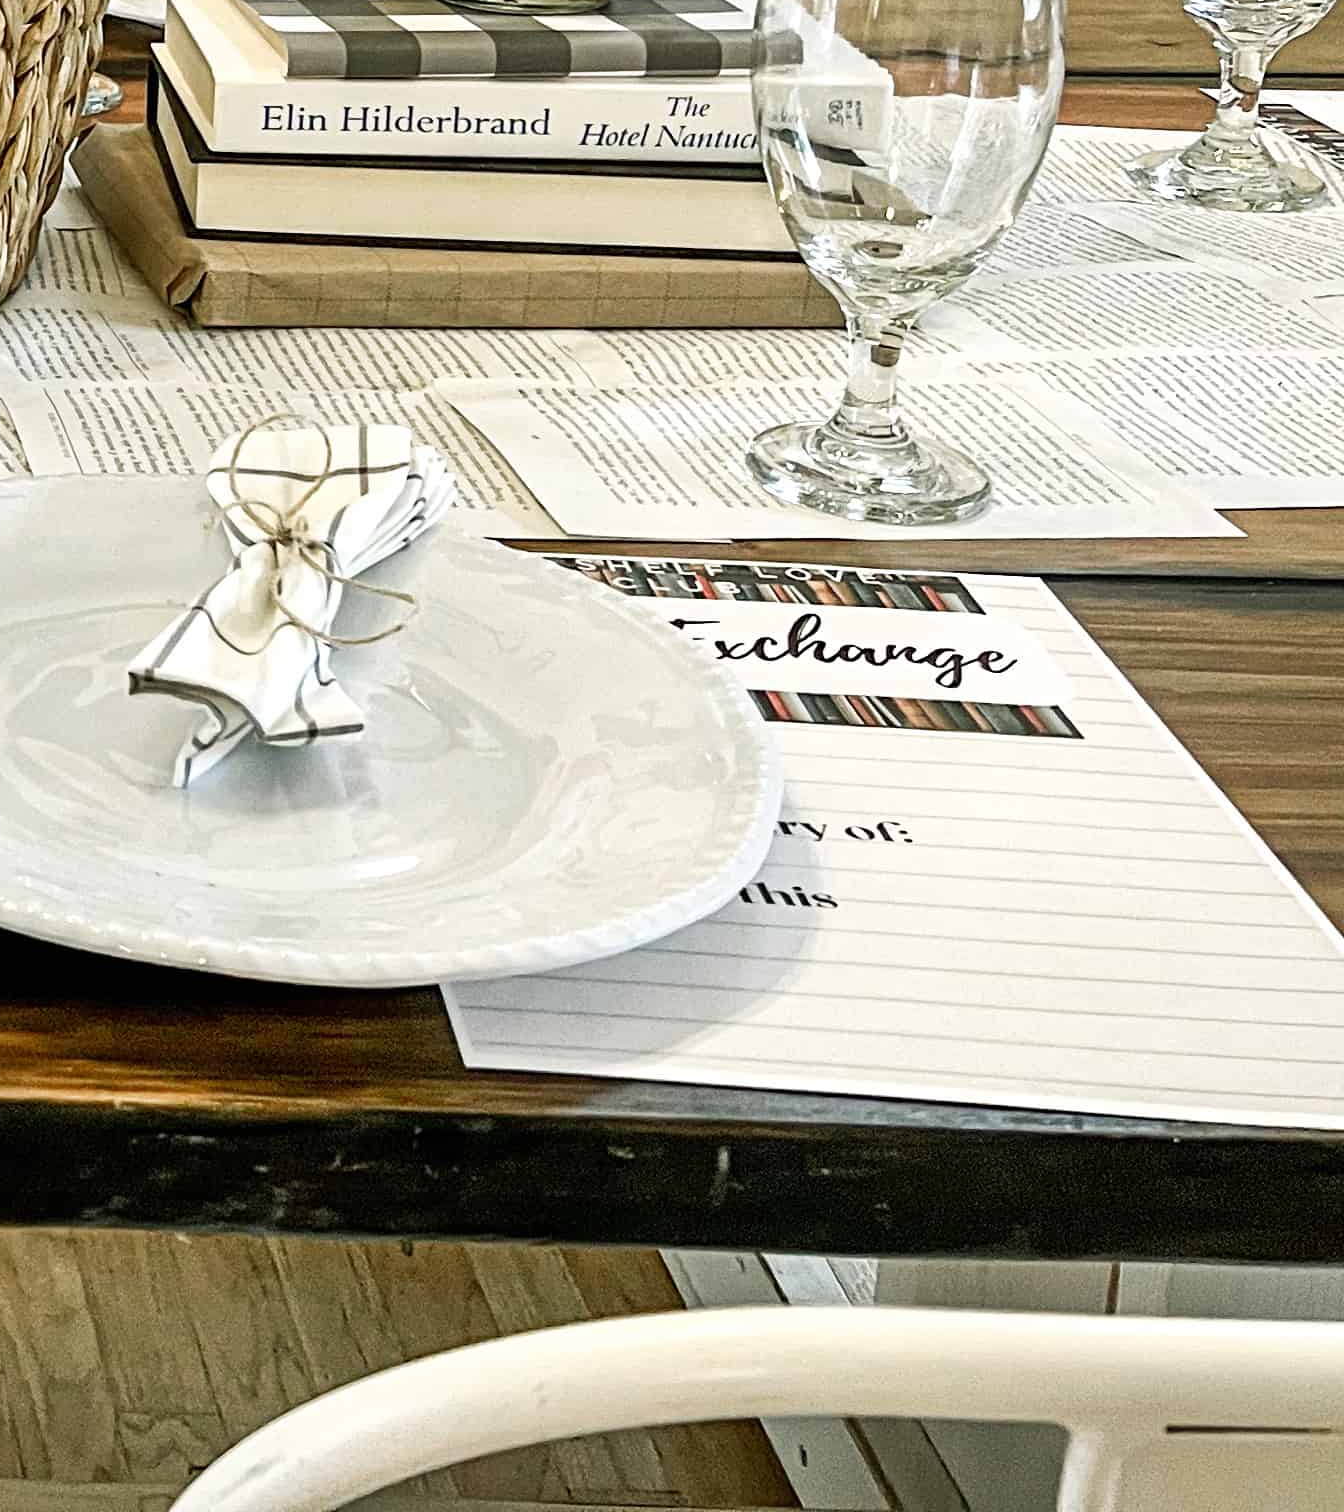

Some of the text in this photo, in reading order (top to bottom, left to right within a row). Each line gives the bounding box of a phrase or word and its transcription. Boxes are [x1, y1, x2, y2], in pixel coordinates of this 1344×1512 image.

[667, 96, 710, 118] The
[261, 104, 551, 138] Elin Hilderbrand
[579, 122, 760, 150] Hotel Nantuc
[574, 557, 724, 577] SHELF
[613, 576, 741, 595] CLUB
